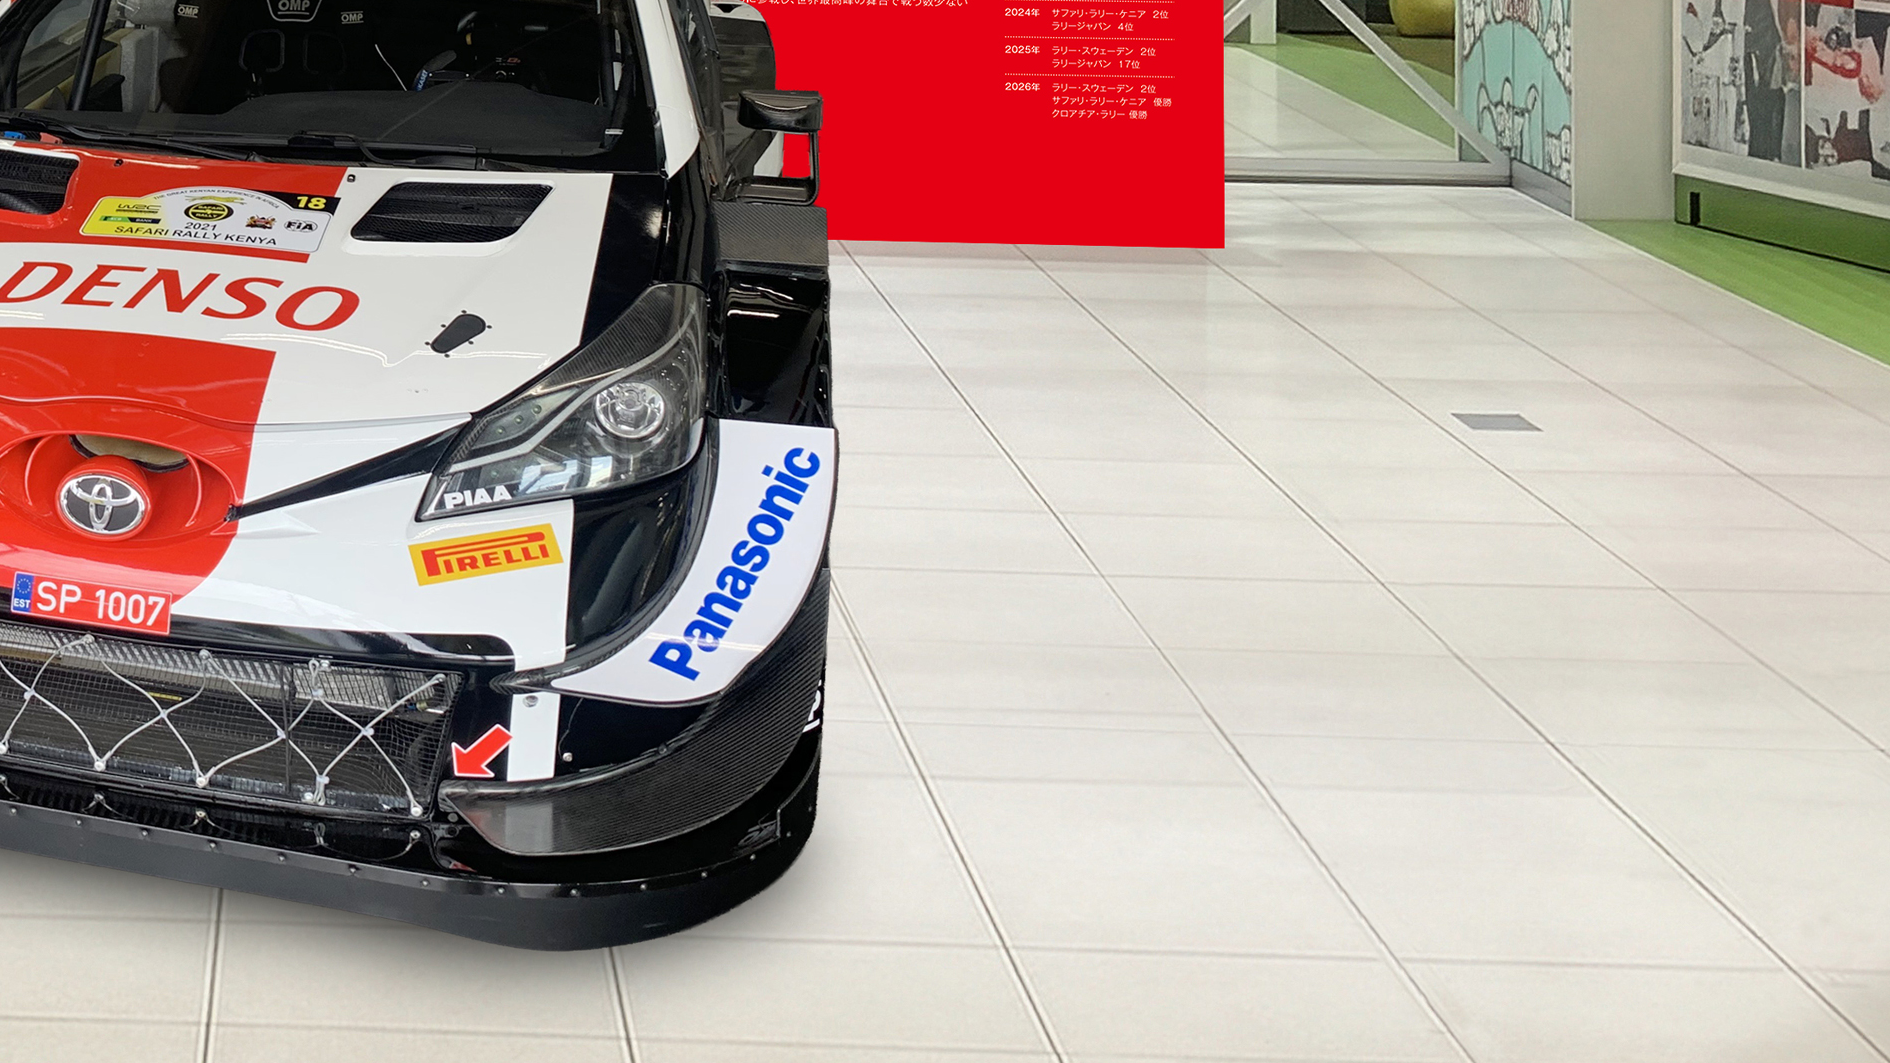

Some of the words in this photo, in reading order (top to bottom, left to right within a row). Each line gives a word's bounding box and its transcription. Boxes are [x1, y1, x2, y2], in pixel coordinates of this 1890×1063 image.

[1004, 8, 1040, 17] 2024年
[1052, 9, 1146, 18] サファリ・ラリー・ケニア
[1152, 10, 1169, 19] 2位
[1052, 21, 1111, 31] ラリージャパン
[1117, 22, 1134, 31] 4位
[1004, 45, 1040, 54] 2025年
[1052, 46, 1134, 56] ラリー・スウェーデン
[1140, 47, 1157, 57] 2位
[1052, 59, 1111, 68] ラリージャパン
[1118, 59, 1140, 69] 17位
[1005, 82, 1041, 92] 2026年
[1052, 83, 1134, 93] ラリー・スウェーデン
[1140, 84, 1157, 94] 2位
[1052, 96, 1147, 106] サファリ・ラリー・ケニア
[1153, 97, 1172, 107] 優勝
[1052, 109, 1126, 119] クロアチア・ラリー
[1128, 110, 1148, 120] 優勝
[296, 196, 327, 209] 18
[184, 222, 217, 230] 2021
[114, 225, 170, 236] SAFARI
[173, 229, 222, 240] RALLY
[224, 233, 277, 246] KENYA
[442, 485, 513, 510] PIAA
[422, 530, 551, 577] PIRELLI
[648, 447, 821, 682] Panasonic
[13, 596, 32, 610] EST
[36, 580, 83, 616] SP
[93, 587, 168, 628] 1007
